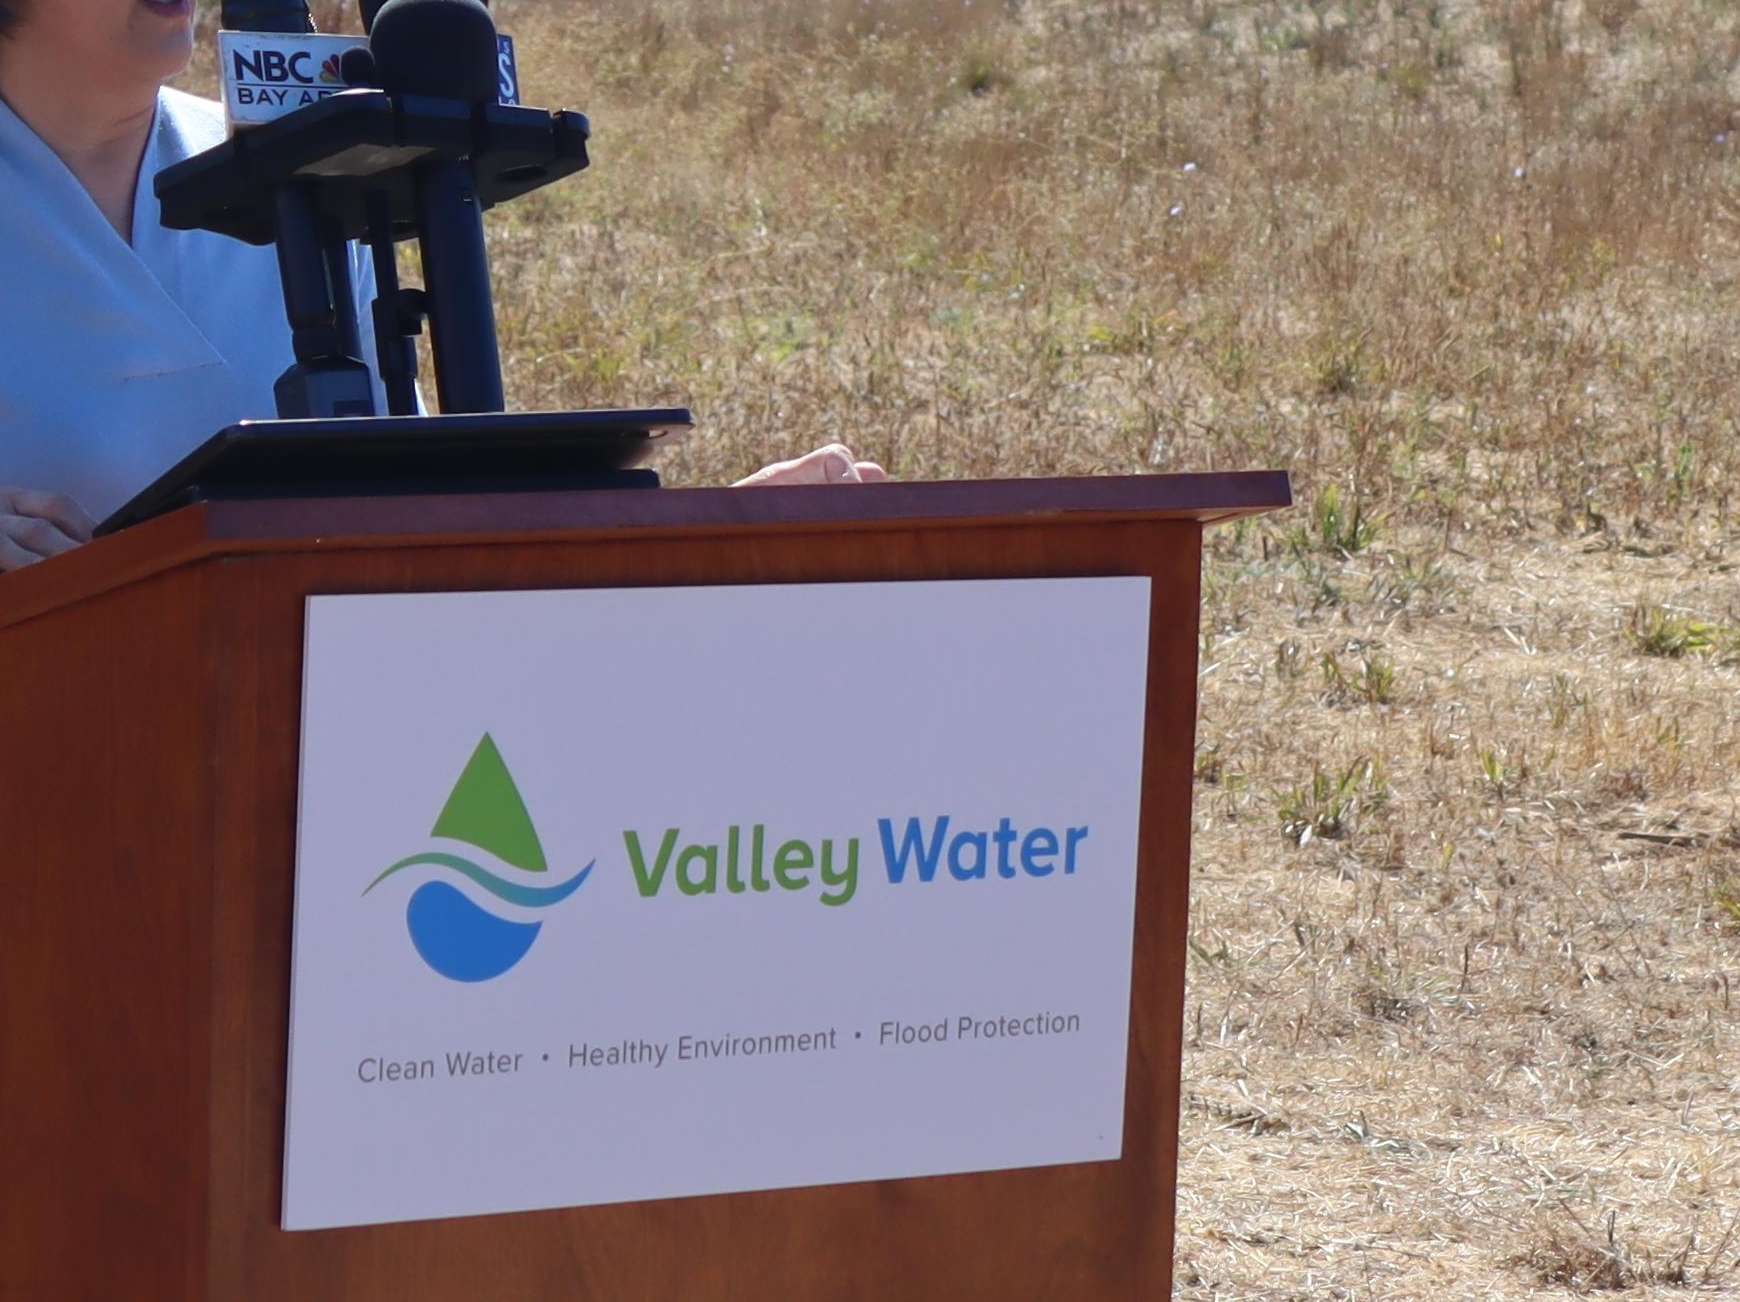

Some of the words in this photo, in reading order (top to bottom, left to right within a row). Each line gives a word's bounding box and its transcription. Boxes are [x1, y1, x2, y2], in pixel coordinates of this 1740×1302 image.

[232, 49, 314, 84] NBC
[237, 87, 288, 105] BAY
[622, 823, 860, 907] Valley
[876, 815, 1089, 884] Water
[357, 1057, 435, 1083] Clean
[446, 1051, 523, 1077] Water
[568, 1039, 669, 1069] Healthy
[677, 1027, 837, 1060] Environment
[879, 1017, 948, 1046] Flood
[957, 1011, 1081, 1040] Protection
